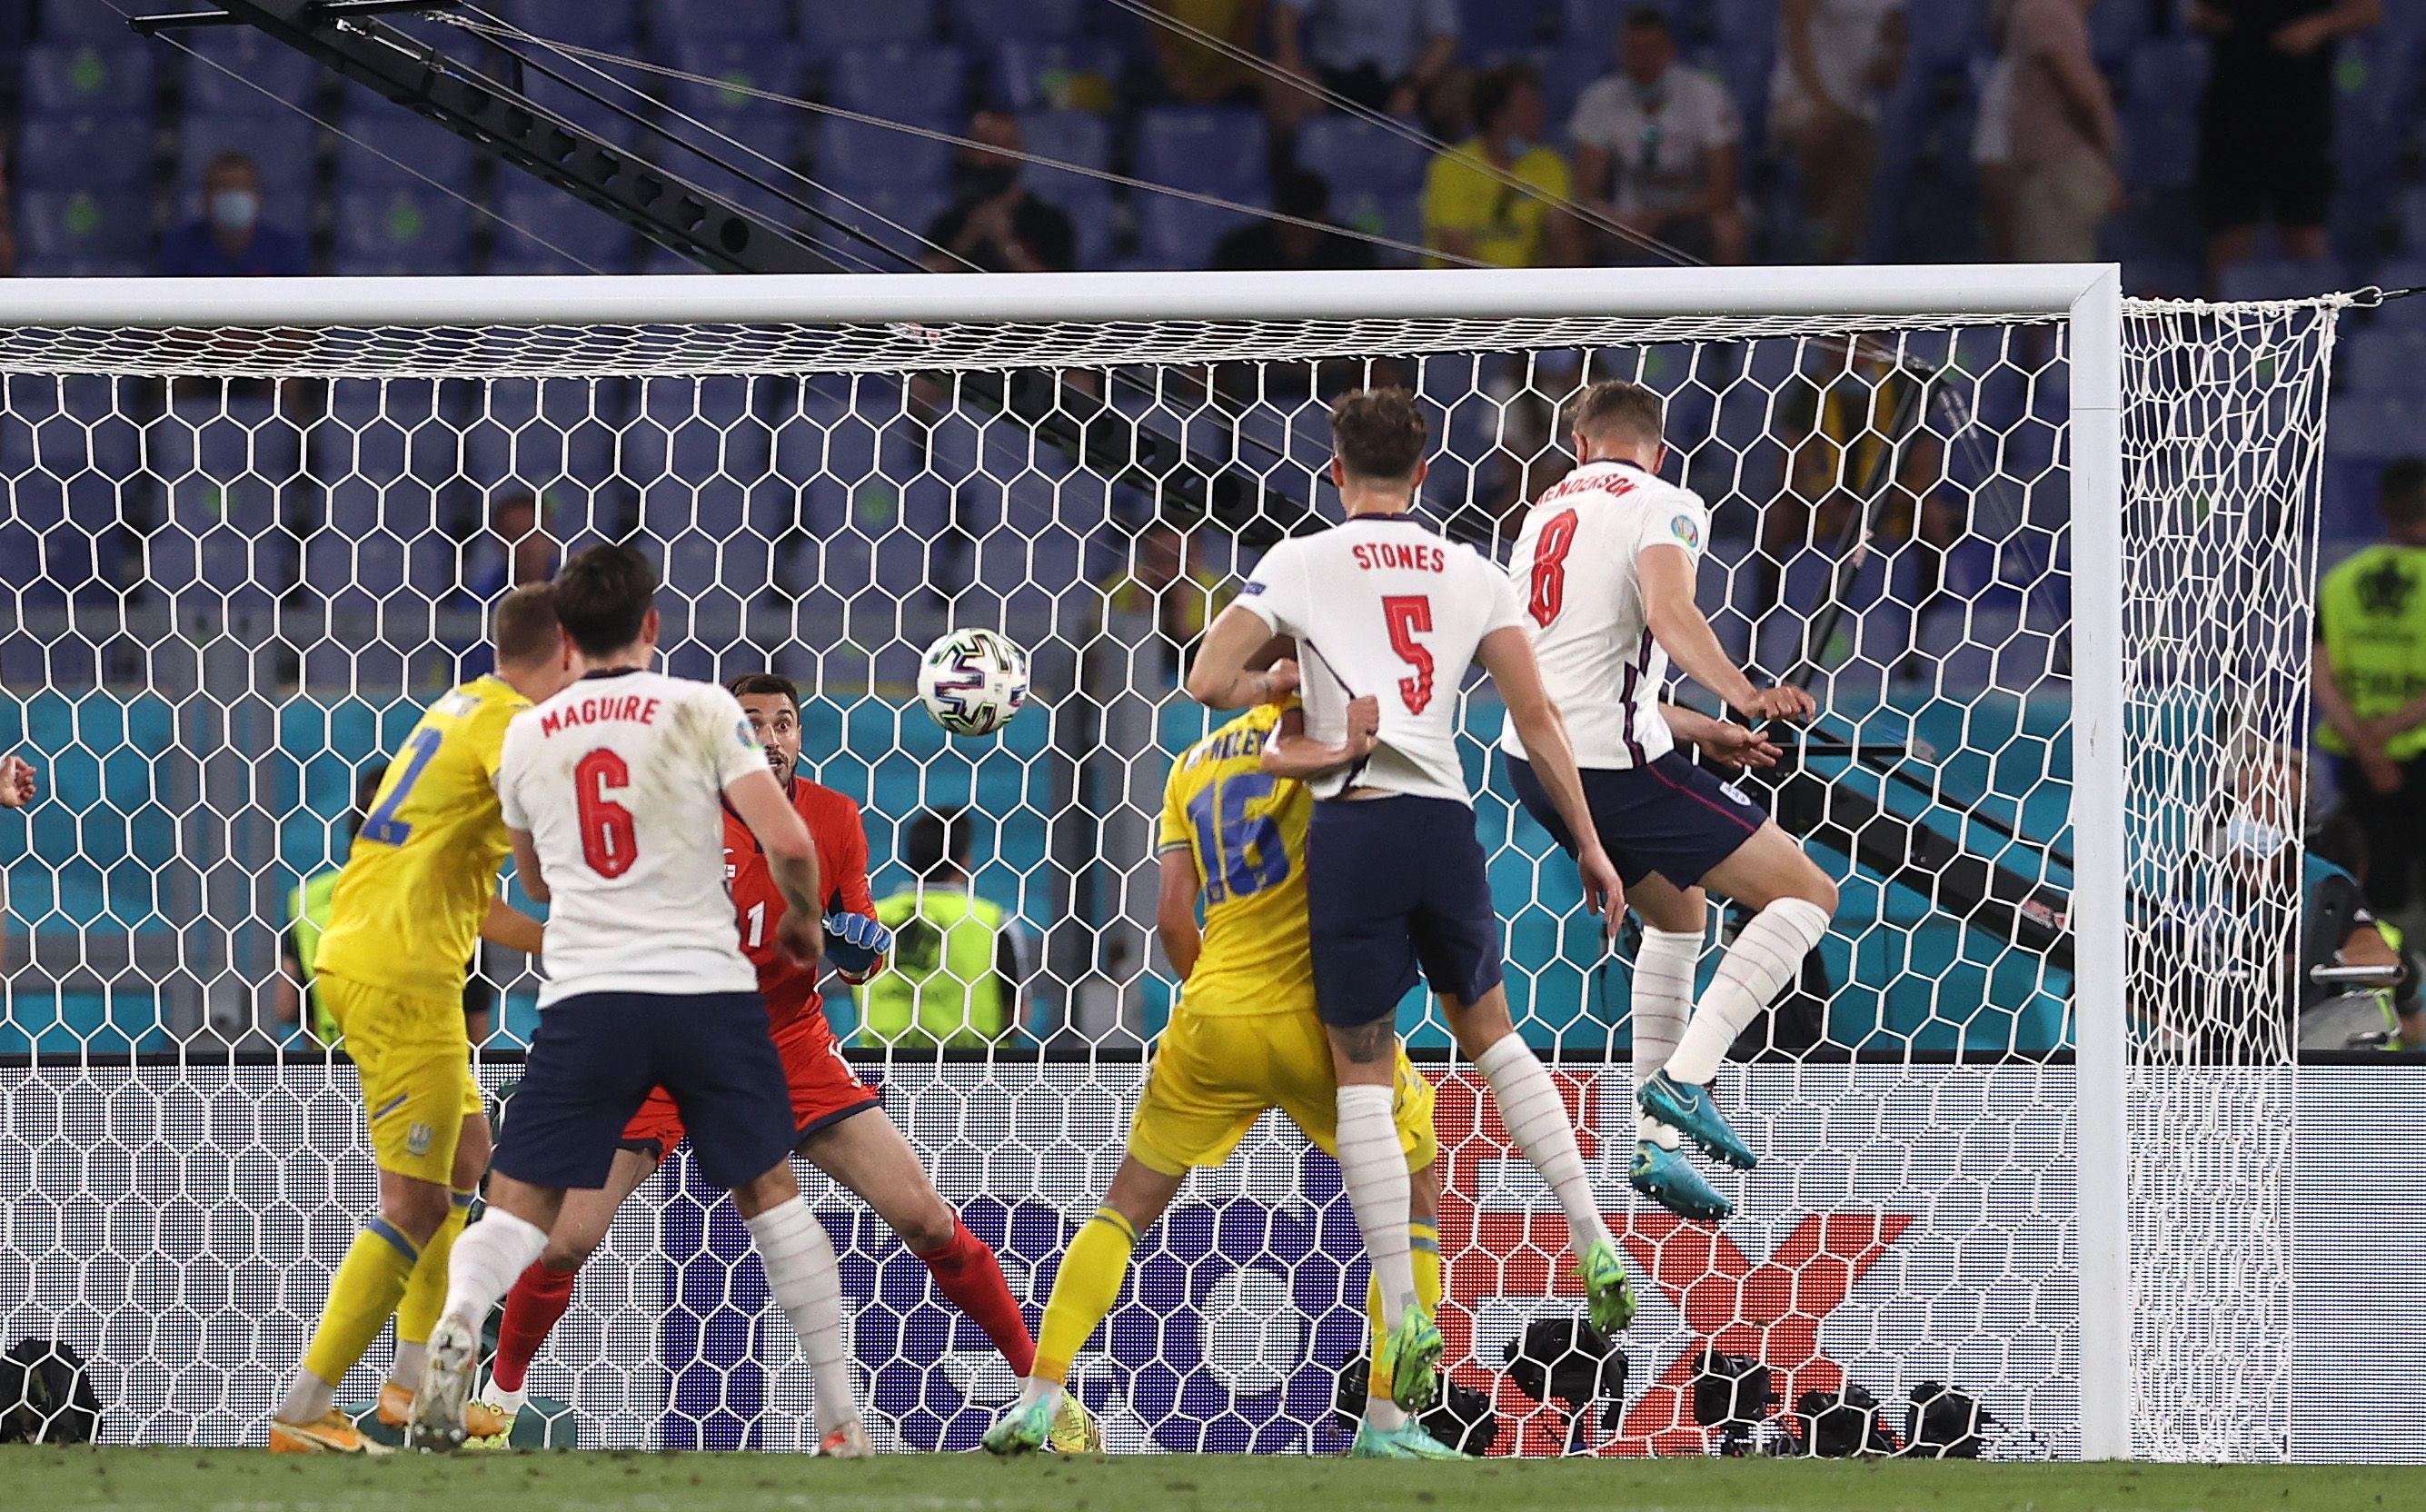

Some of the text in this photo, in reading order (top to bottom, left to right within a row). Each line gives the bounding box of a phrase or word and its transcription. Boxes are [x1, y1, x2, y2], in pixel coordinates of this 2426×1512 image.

[1352, 542, 1445, 573] STONES
[1528, 508, 1578, 629] 8
[1381, 595, 1434, 716] 5
[542, 695, 661, 738] MAGUIRE
[363, 727, 442, 847] 2
[575, 747, 638, 880] 6
[1187, 772, 1290, 905] 16
[747, 900, 765, 948] 1
